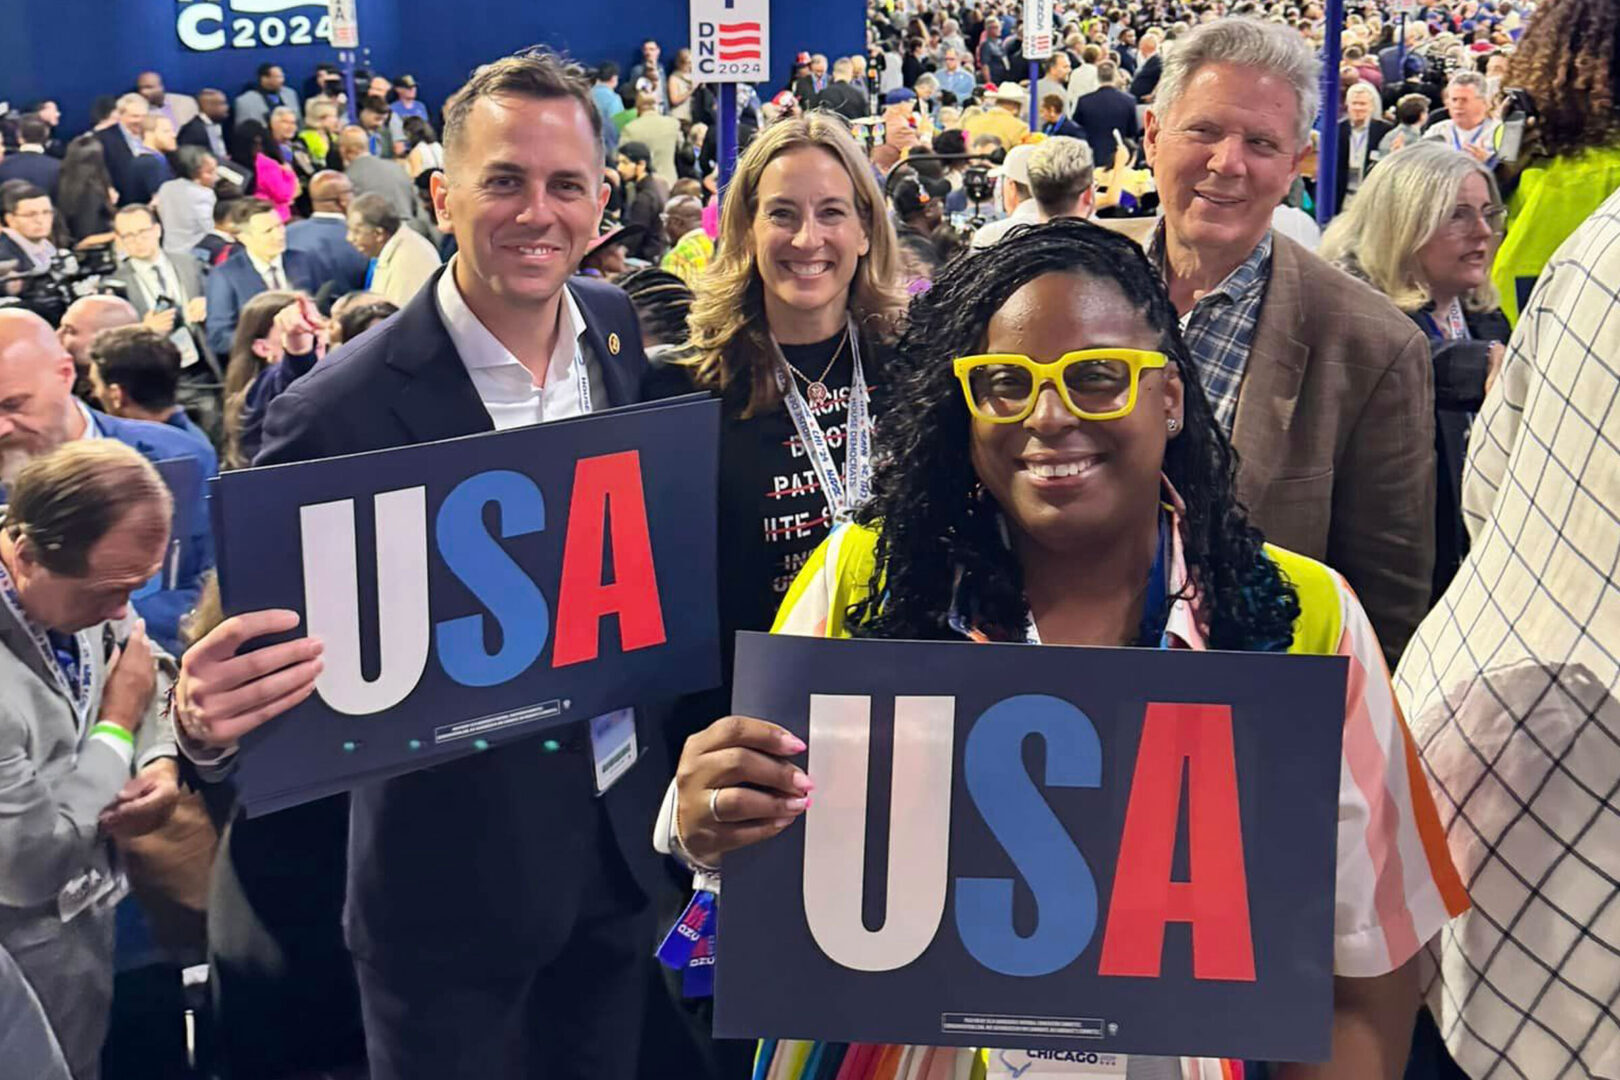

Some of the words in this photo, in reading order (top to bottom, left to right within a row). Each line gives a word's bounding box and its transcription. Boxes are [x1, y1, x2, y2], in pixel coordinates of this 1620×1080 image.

[232, 16, 333, 48] 2024
[718, 62, 761, 74] 2024
[848, 397, 859, 428] HOUSE
[847, 430, 858, 488] DEMOCRATS
[299, 449, 668, 716] USA
[802, 693, 1257, 982] USA
[1026, 1048, 1098, 1065] CHICAGO
